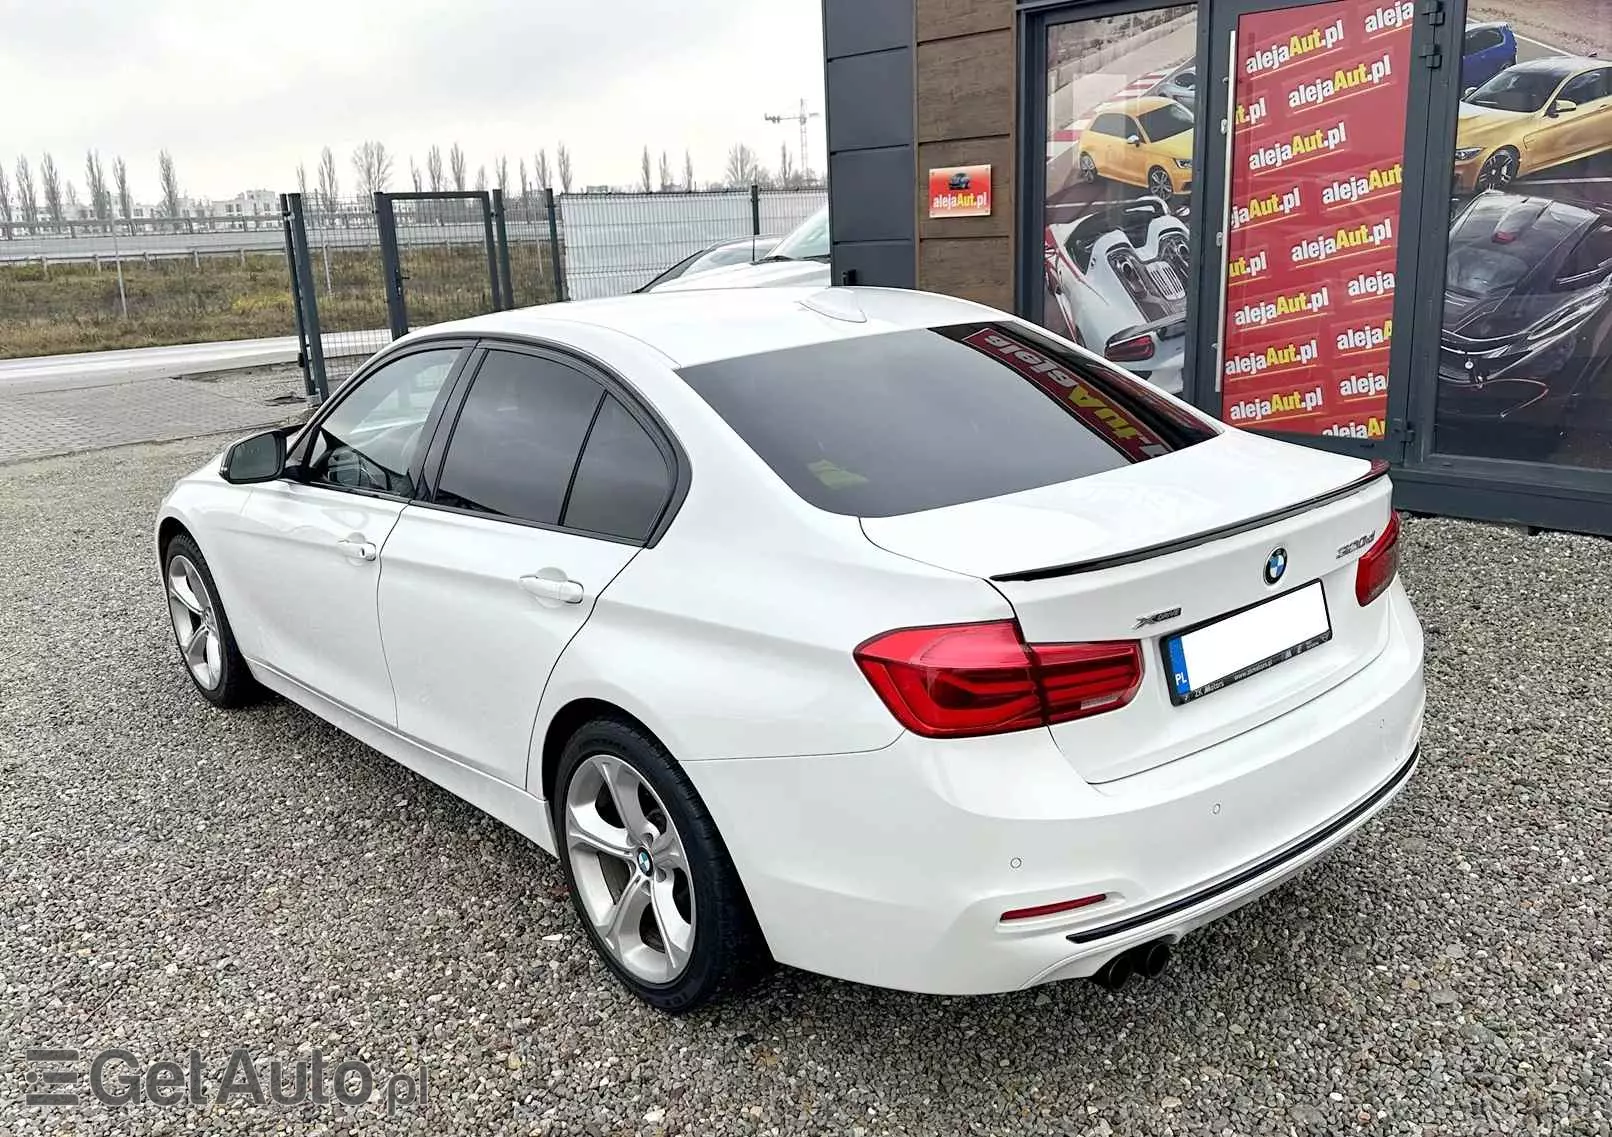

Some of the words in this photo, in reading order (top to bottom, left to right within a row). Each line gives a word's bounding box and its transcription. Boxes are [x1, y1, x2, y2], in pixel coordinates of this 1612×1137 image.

[1364, 0, 1415, 33] aleja
[1246, 19, 1345, 73] alejaAut.pl
[1288, 55, 1391, 108] alejaAut.pl
[1249, 122, 1346, 169] alejaAut.pl
[933, 192, 987, 210] alejaAut.pl
[1322, 164, 1402, 204] alejaAut
[1291, 218, 1392, 262] alejaAut.pl
[1348, 271, 1395, 296] aleja
[1234, 287, 1329, 324] alejaAut.pl
[1225, 340, 1318, 375] alejaAut.pl
[1230, 387, 1323, 420] alejaAut.pl
[1175, 673, 1188, 686] PL
